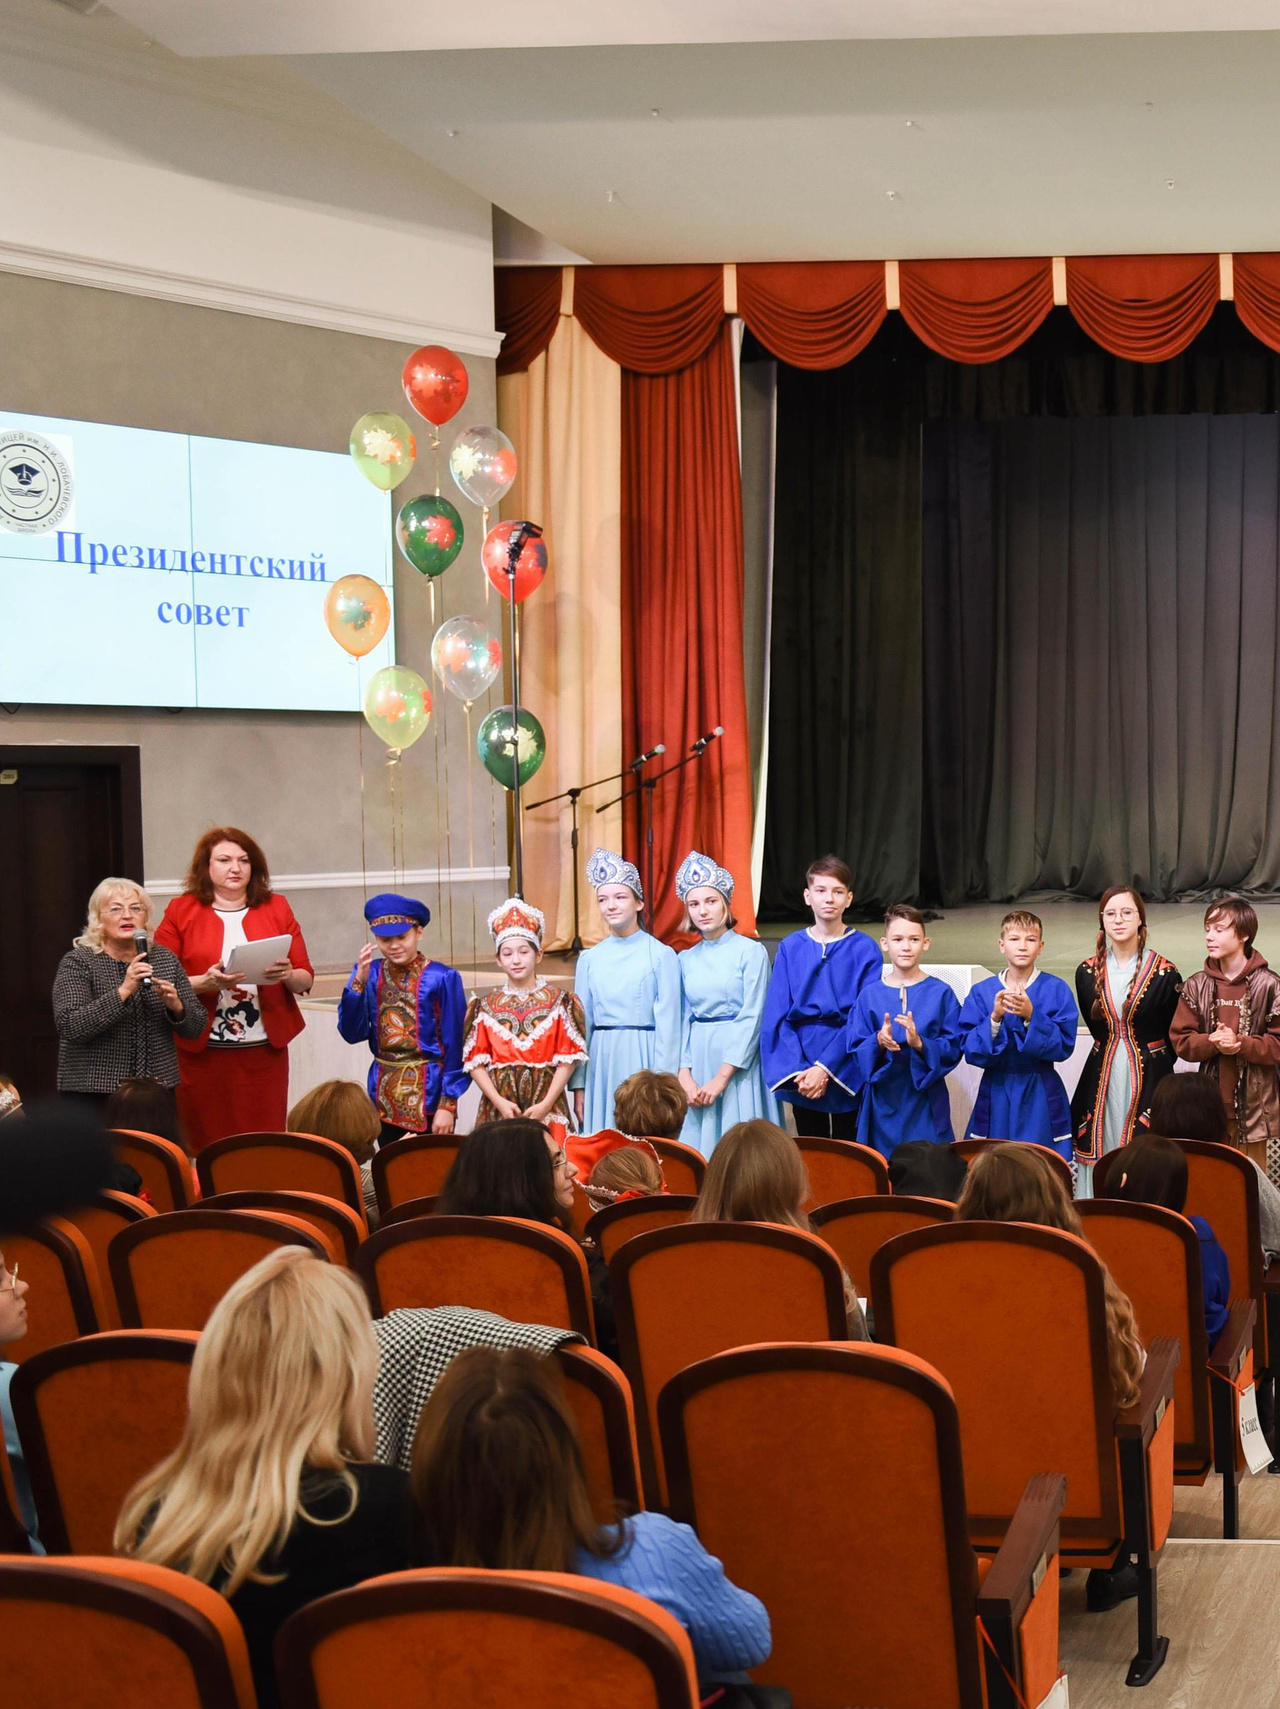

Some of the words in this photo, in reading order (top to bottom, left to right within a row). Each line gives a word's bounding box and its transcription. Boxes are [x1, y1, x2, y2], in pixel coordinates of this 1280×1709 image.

[0, 433, 24, 444] ИЦЕЙ
[54, 530, 327, 581] Президентский
[157, 600, 249, 627] совет
